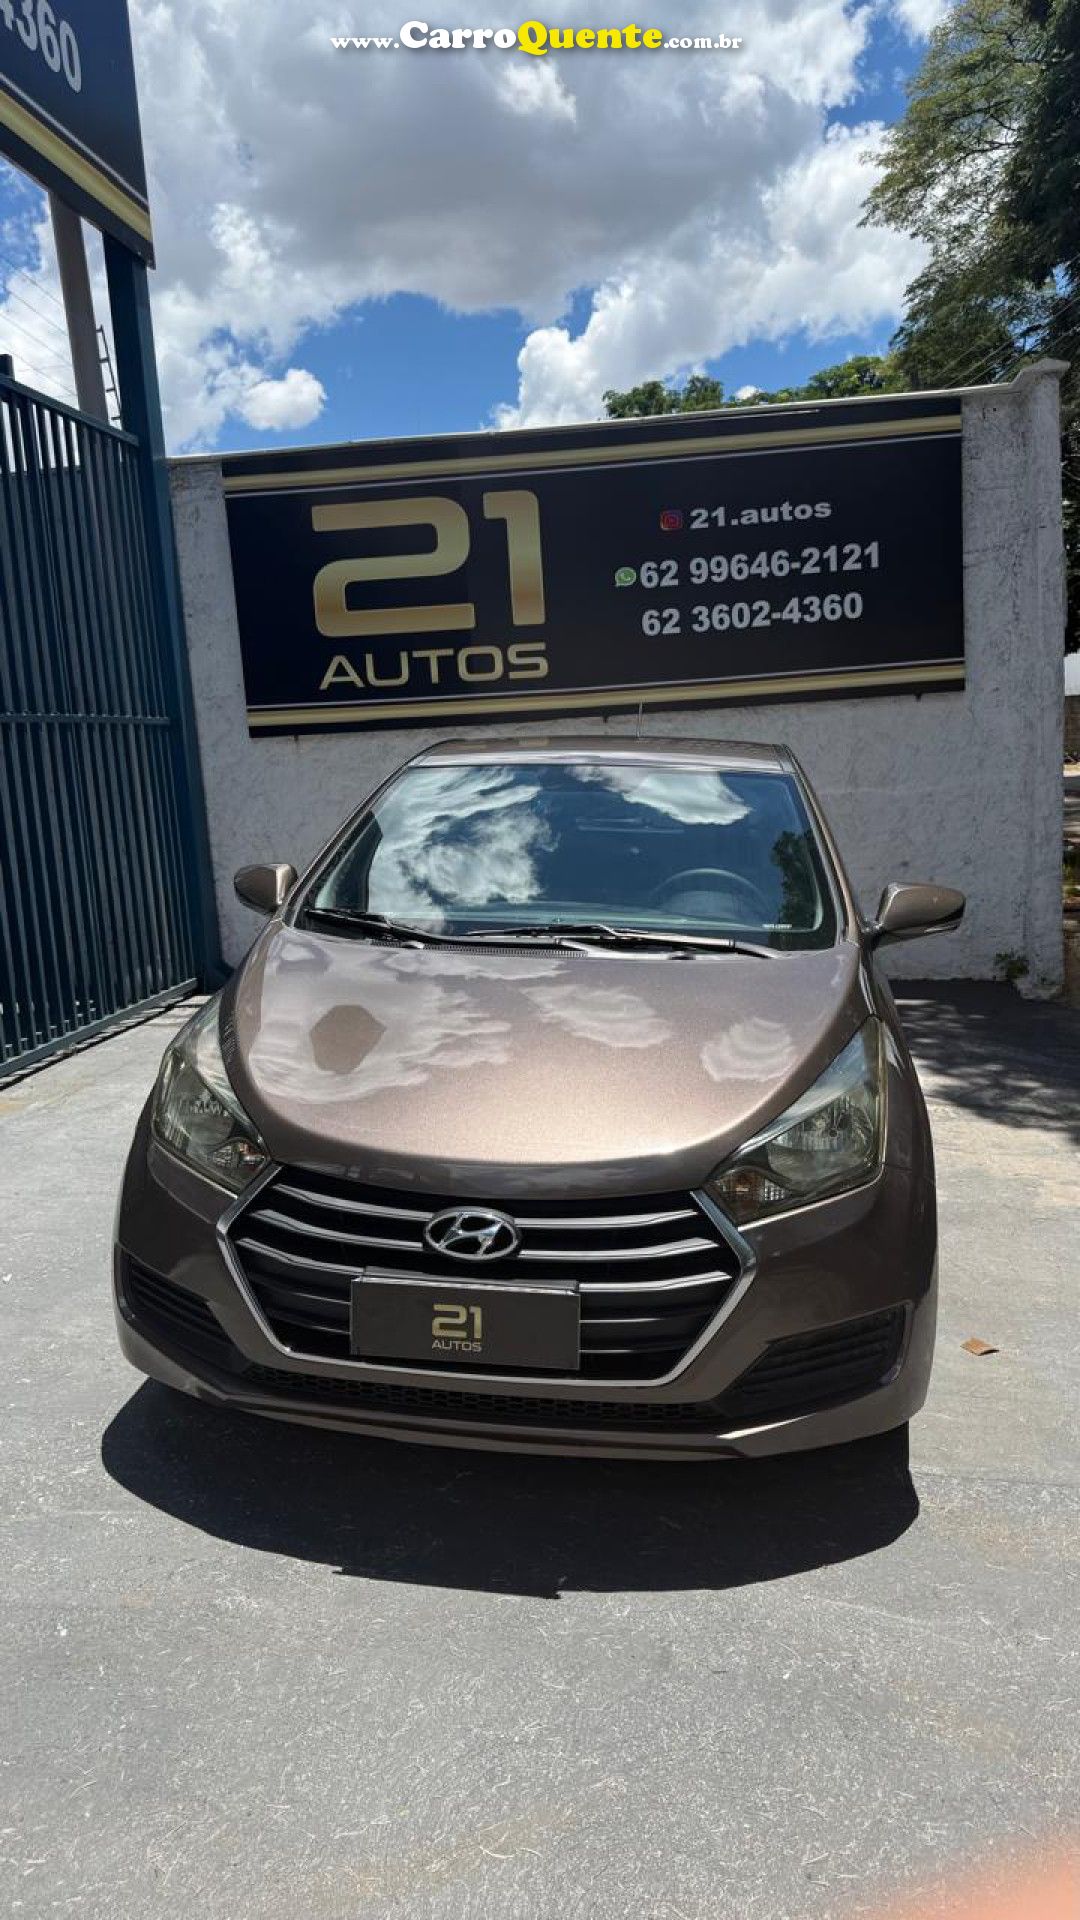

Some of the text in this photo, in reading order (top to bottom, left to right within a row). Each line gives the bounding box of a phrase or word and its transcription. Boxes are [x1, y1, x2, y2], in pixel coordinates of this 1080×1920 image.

[689, 501, 832, 529] 21.autos
[311, 490, 546, 637] 21
[640, 541, 880, 589] 62 99646-2121
[641, 592, 864, 636] 62 3602-4360
[319, 642, 549, 691] AUTOS
[431, 1304, 483, 1339] 21
[431, 1340, 482, 1352] AUTOS
